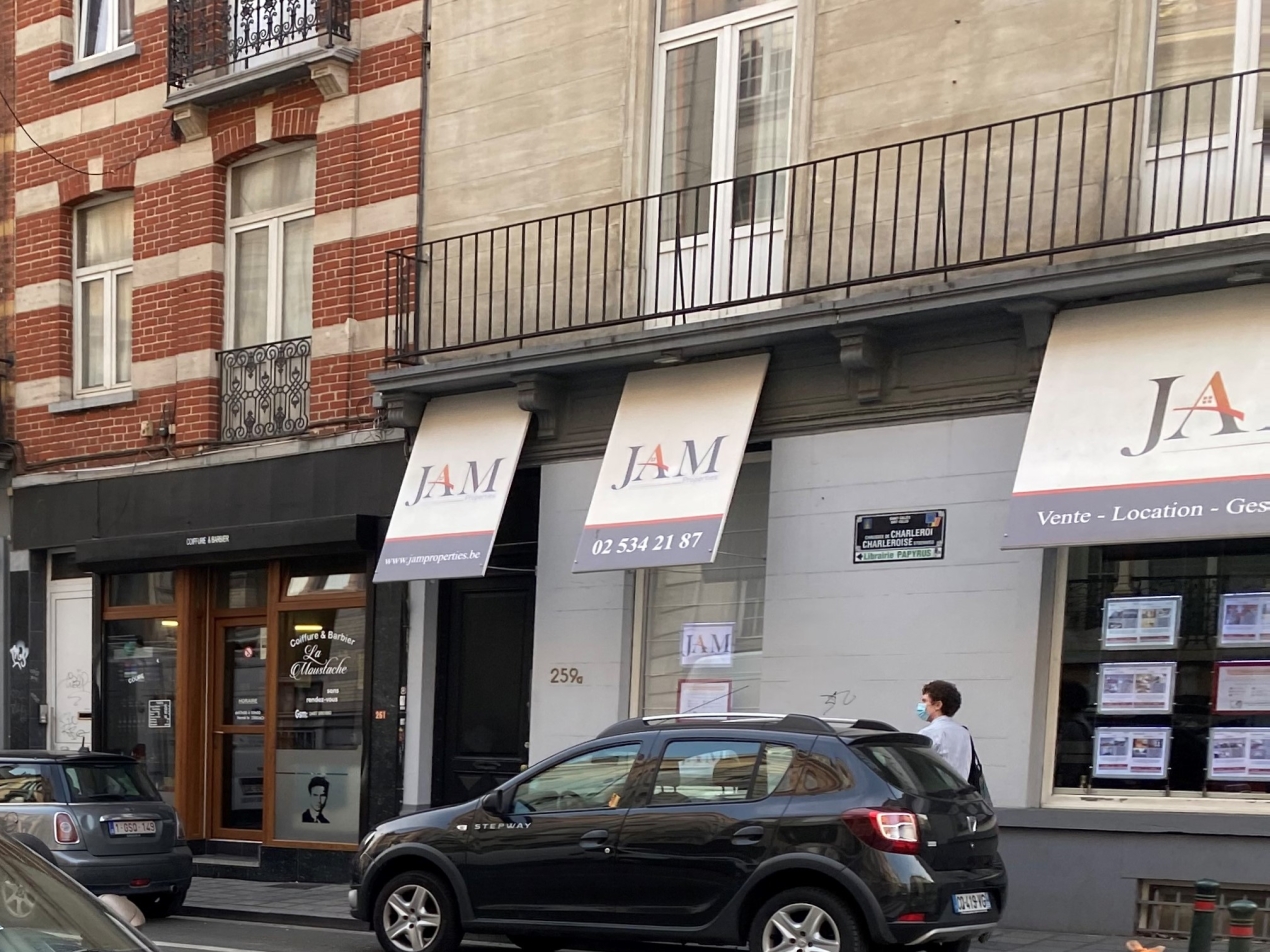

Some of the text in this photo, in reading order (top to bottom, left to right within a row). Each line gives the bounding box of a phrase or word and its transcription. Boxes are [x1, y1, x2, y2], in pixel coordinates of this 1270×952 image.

[1121, 371, 1270, 457] JA
[611, 435, 729, 490] JAM
[405, 457, 507, 507] JAM
[1037, 510, 1092, 526] Vente
[1111, 502, 1203, 522] Location
[592, 532, 703, 556] 02 534 21 87
[862, 538, 913, 549] CHARLEROISE
[890, 527, 933, 539] CHARLEROI
[385, 549, 481, 566] www.jamproperties.be
[863, 549, 932, 561] Librairie PAPYRUS
[290, 630, 356, 648] Coiffure & Barbier
[682, 633, 732, 657] JAM
[303, 644, 327, 666] La
[289, 656, 351, 680] Moustache
[550, 667, 584, 685] 259a
[474, 822, 532, 830] STEPWAY
